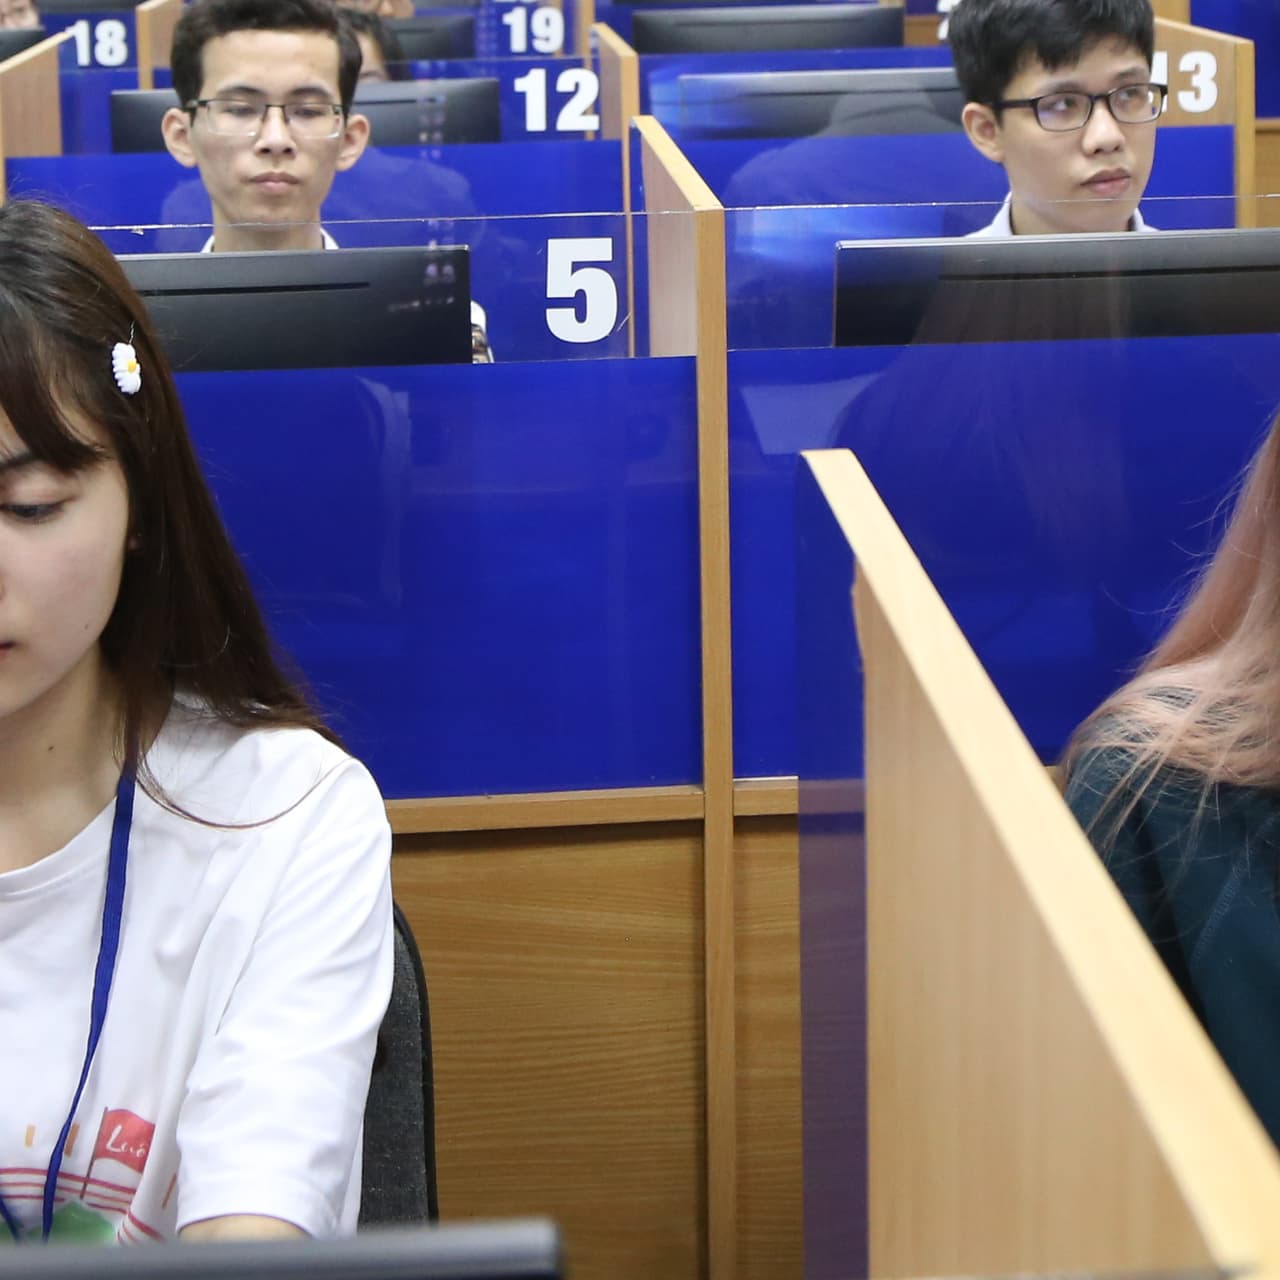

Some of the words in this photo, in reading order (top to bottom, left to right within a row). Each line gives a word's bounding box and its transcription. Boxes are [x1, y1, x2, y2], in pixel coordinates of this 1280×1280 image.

[65, 19, 128, 67] 18
[502, 6, 565, 53] 19
[514, 68, 600, 131] 12
[545, 237, 618, 343] 5
